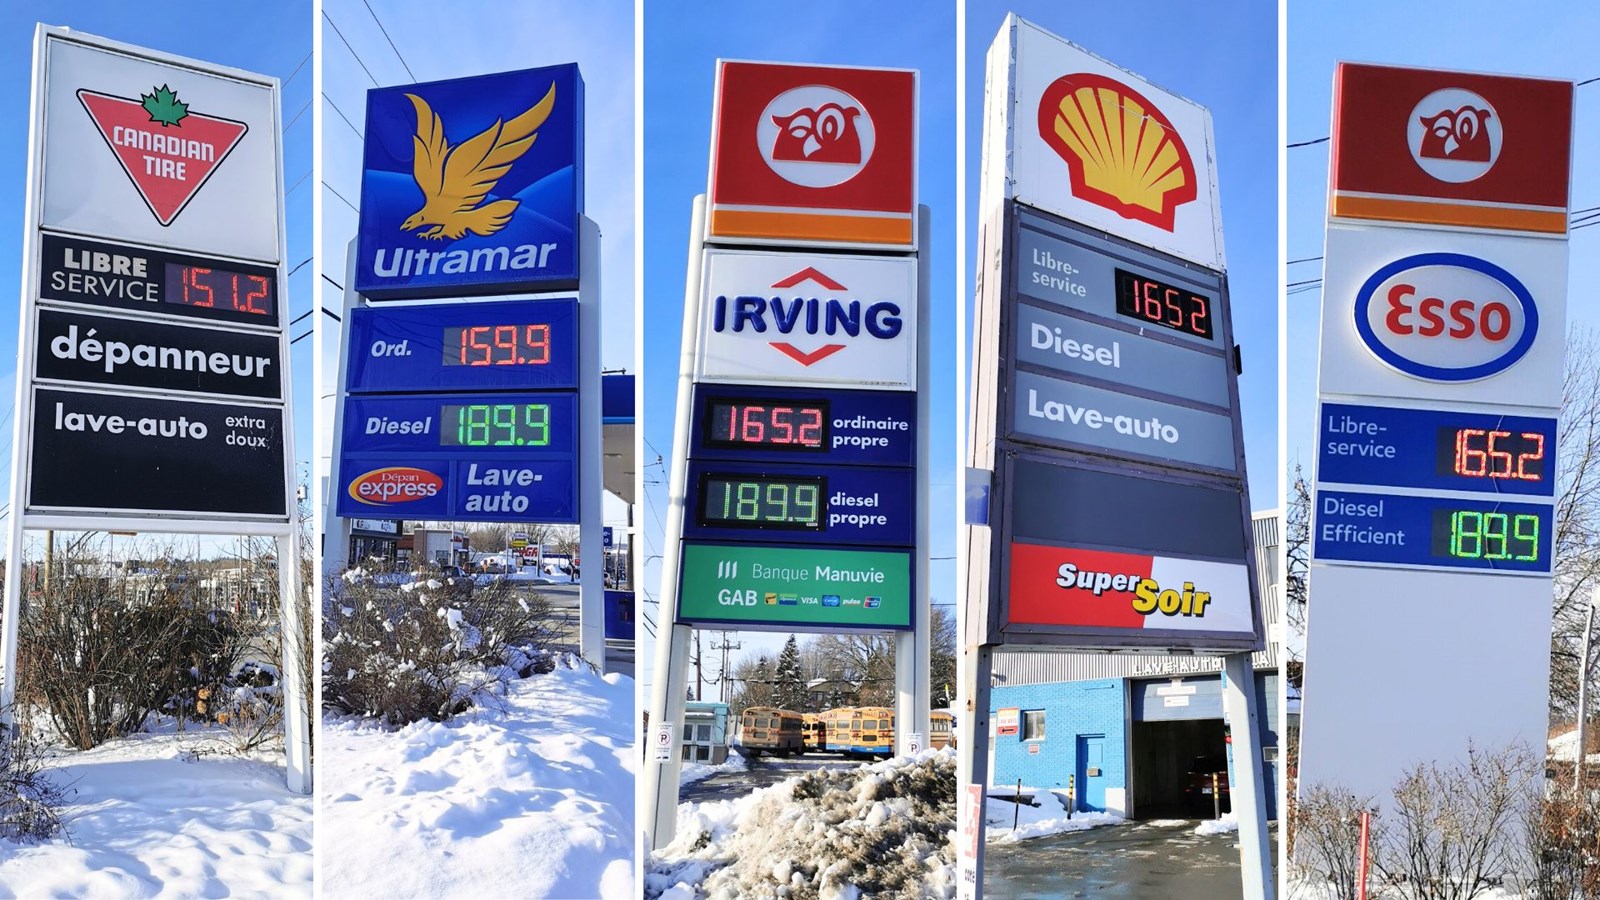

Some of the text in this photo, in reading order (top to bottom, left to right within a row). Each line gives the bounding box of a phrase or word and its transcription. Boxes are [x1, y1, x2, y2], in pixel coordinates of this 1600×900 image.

[113, 125, 214, 163] CANADIAN
[143, 155, 186, 181] TIRE
[64, 247, 148, 279] LIBRE
[373, 243, 557, 278] Ultramar
[1033, 248, 1080, 275] Libre-
[51, 270, 159, 303] SERVICE
[182, 267, 268, 315] 151.2
[1032, 270, 1087, 298] service
[713, 295, 903, 340] IRVING
[50, 324, 271, 378] dépanneur
[371, 339, 412, 357] Ord.
[460, 324, 550, 366] 159.9
[1031, 322, 1120, 369] Diesel
[55, 402, 208, 440] lave-auto
[225, 414, 266, 430] extra
[365, 416, 432, 435] Diesel
[458, 404, 549, 446] 189.9
[729, 406, 823, 445] 165.2
[833, 415, 909, 431] ordinaire
[1028, 389, 1179, 444] Lave-auto
[1328, 415, 1387, 436] Libre-
[225, 430, 266, 447] doux
[833, 434, 889, 449] propre
[1327, 440, 1396, 459] service
[1454, 429, 1544, 480] 165.2
[381, 472, 419, 483] Dépan
[467, 463, 543, 486] Lave-
[359, 481, 438, 500] express
[465, 490, 529, 513] auto
[723, 482, 817, 522] 189.9
[829, 491, 879, 507] diesel
[829, 512, 887, 528] propre
[1323, 497, 1383, 518] Diesel
[1322, 523, 1405, 546] Efficient
[1450, 511, 1540, 561] 189.9
[752, 563, 885, 583] Banque Manuvie
[717, 588, 758, 606] GAB
[800, 596, 819, 605] VISA
[1056, 562, 1211, 618] Super Soir
